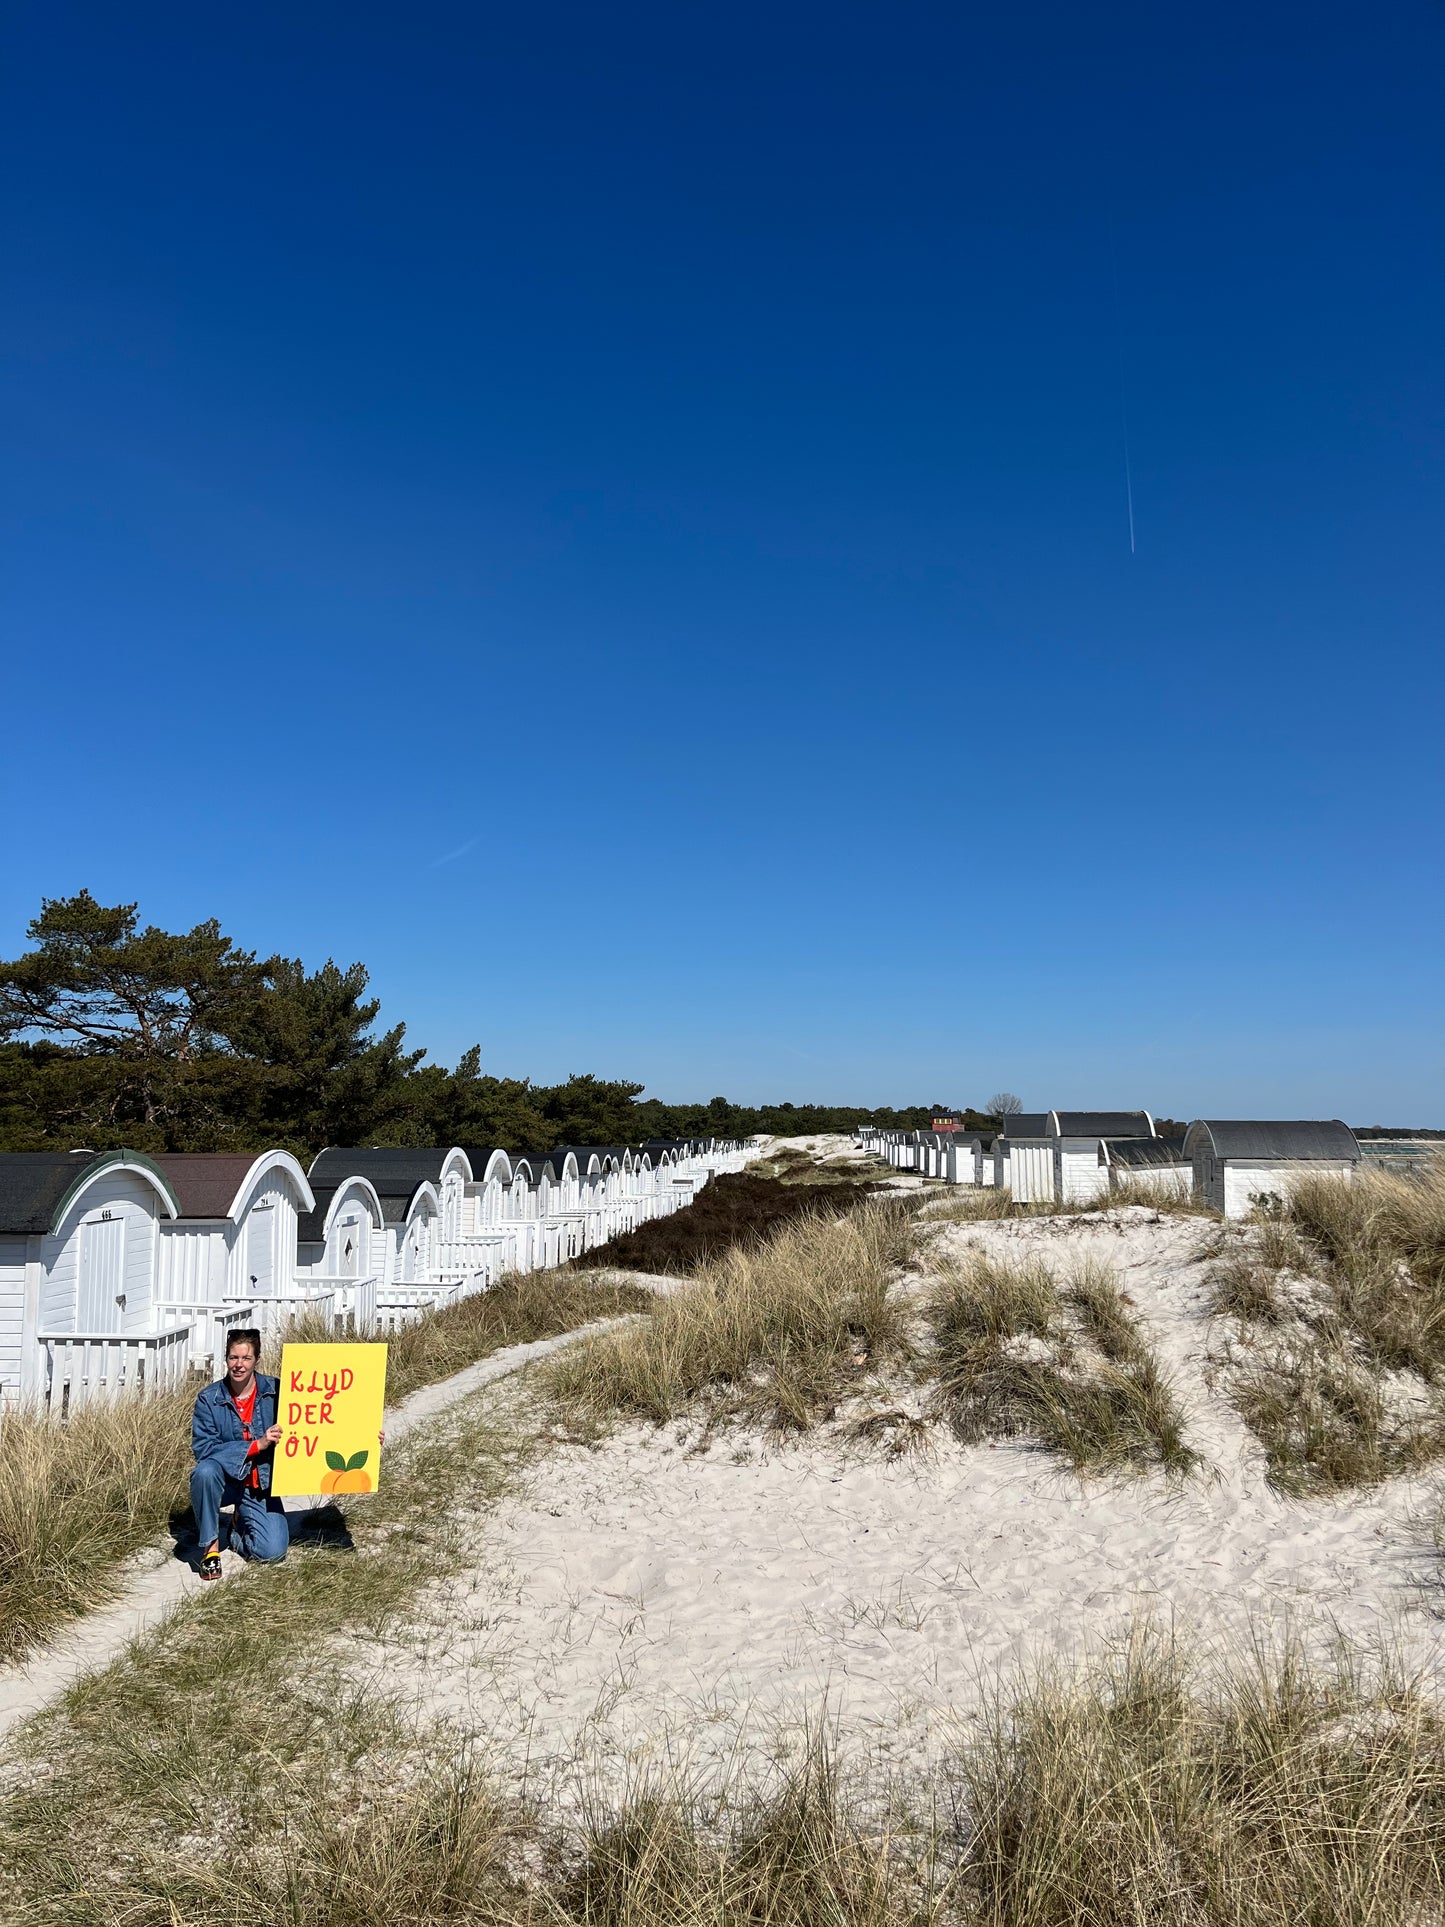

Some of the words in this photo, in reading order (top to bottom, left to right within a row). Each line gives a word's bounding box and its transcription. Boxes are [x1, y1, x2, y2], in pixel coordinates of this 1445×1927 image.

[290, 1368, 354, 1401] KLYD
[288, 1402, 335, 1426] DER
[285, 1431, 319, 1458] ÖV
